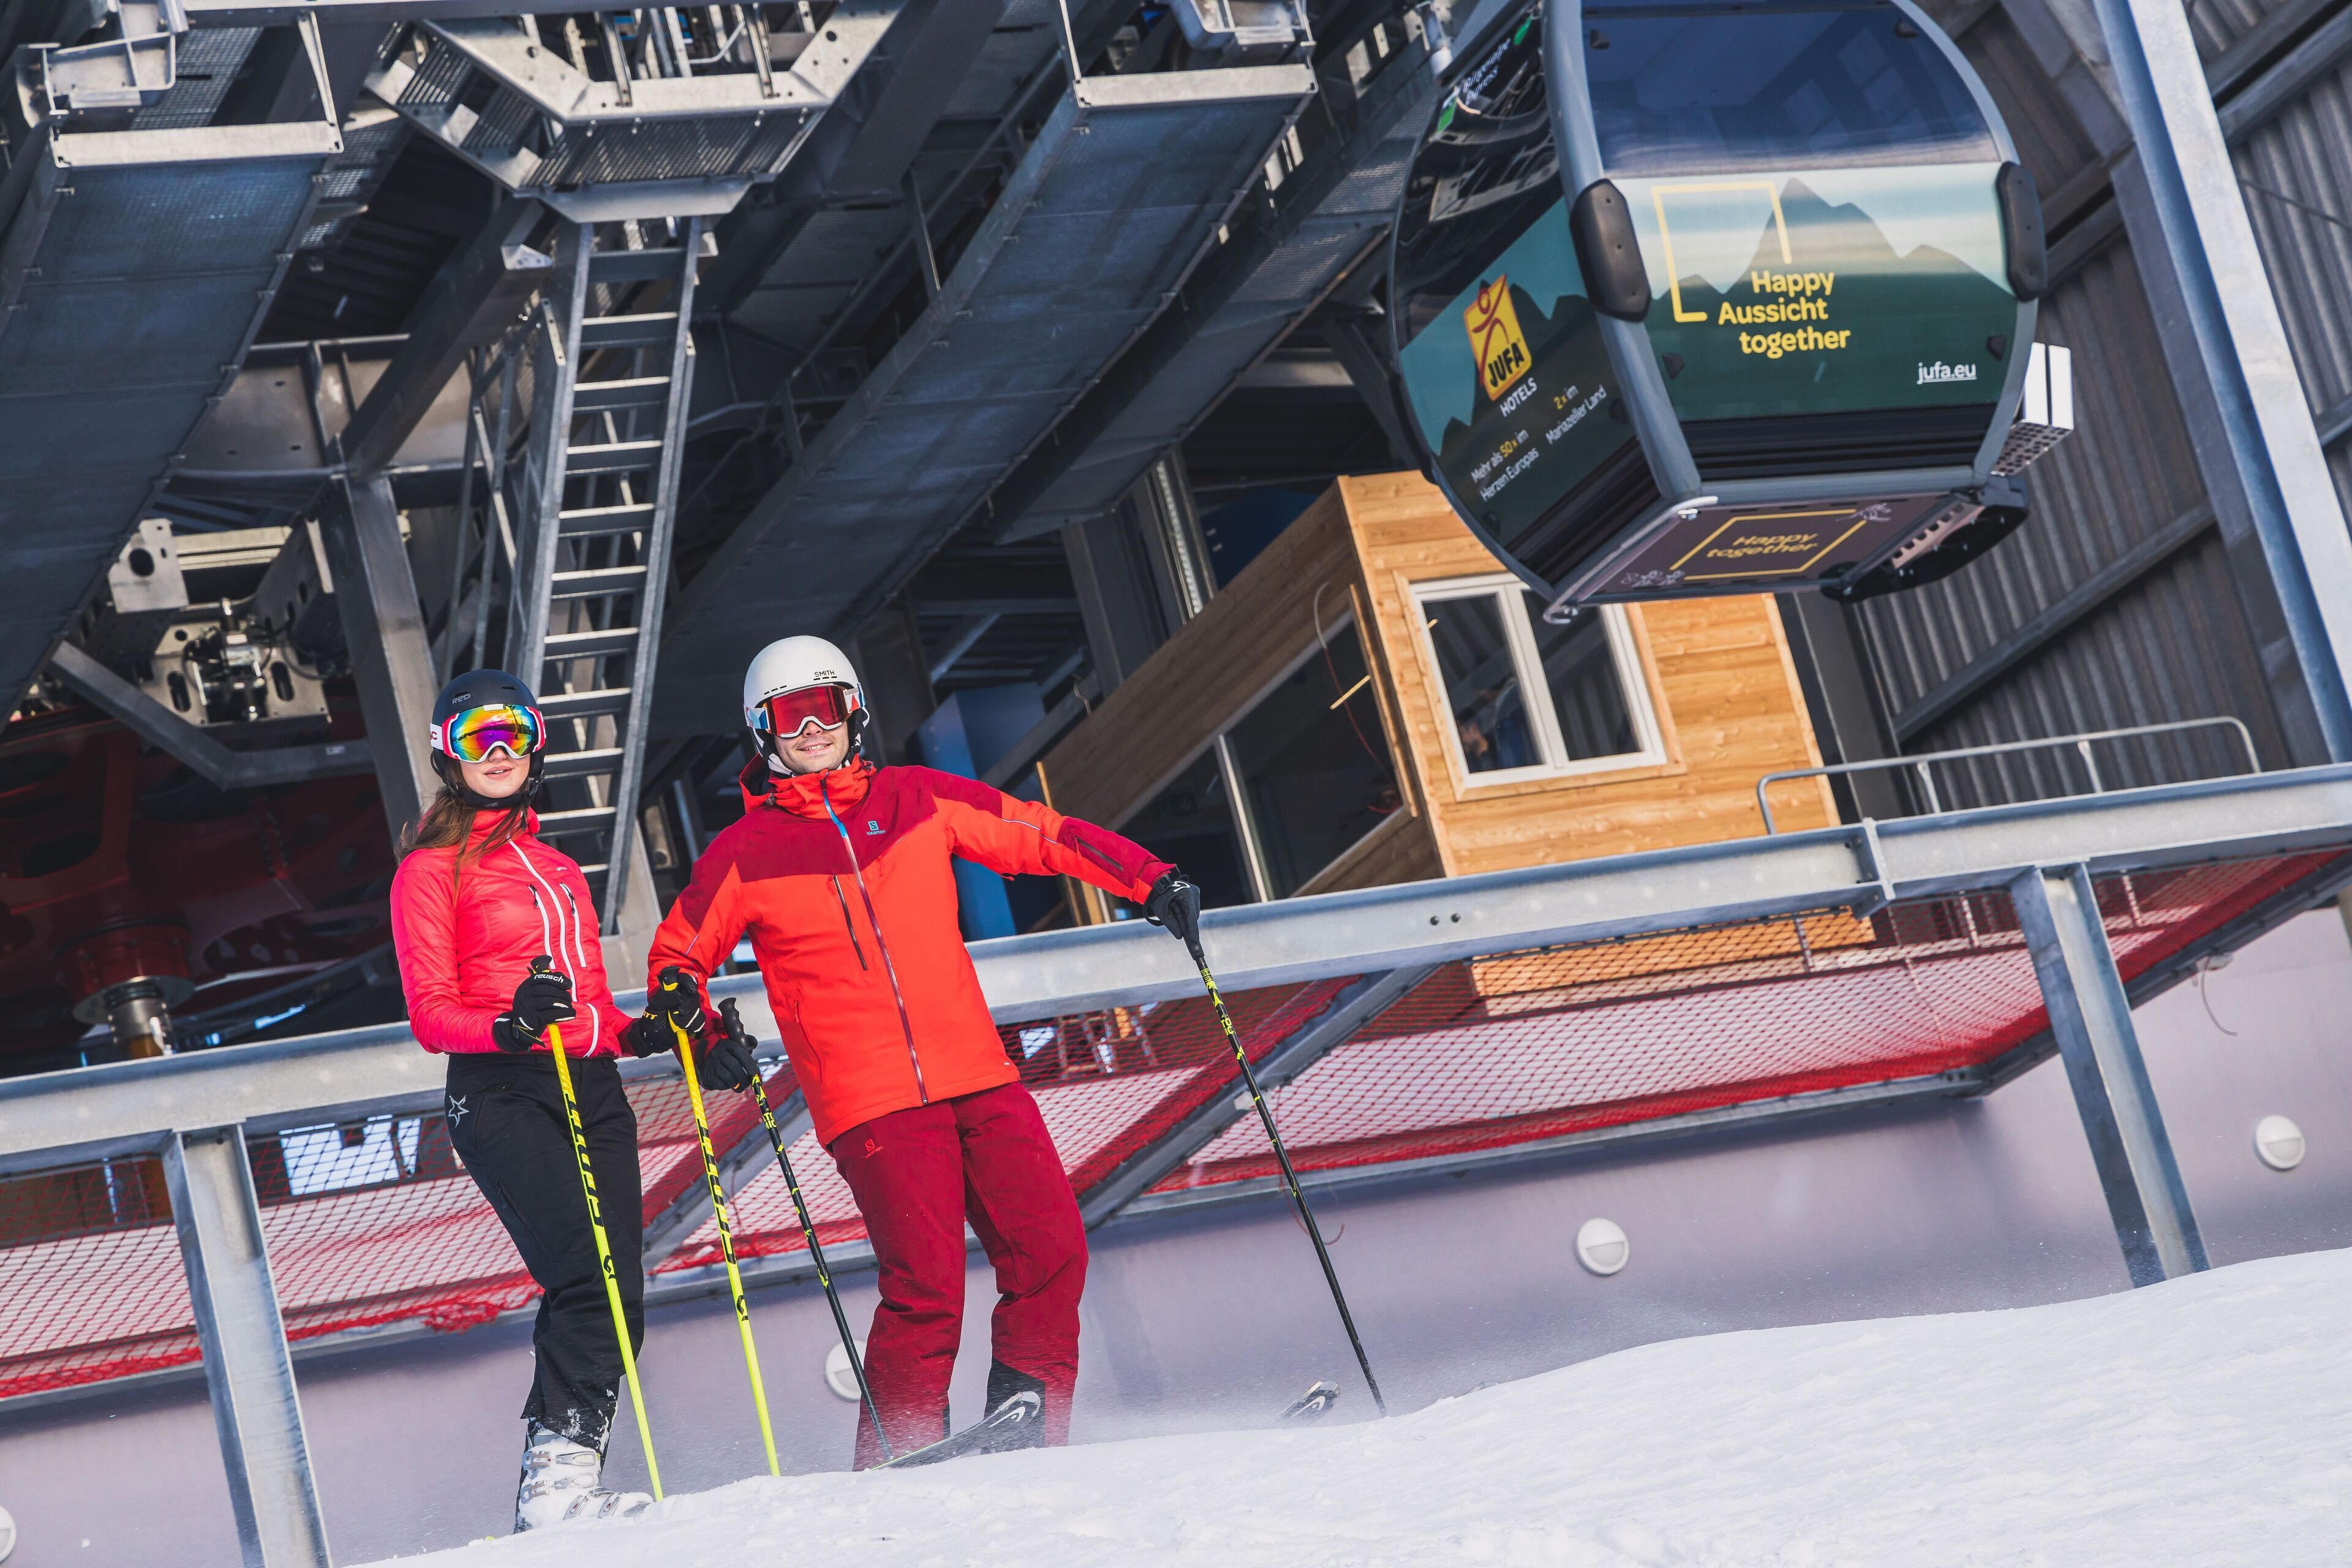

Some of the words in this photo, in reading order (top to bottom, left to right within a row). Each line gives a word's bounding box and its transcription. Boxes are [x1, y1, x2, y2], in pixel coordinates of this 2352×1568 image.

[1751, 270, 1835, 297] Happy
[1718, 296, 1829, 325] Aussicht
[1739, 325, 1851, 359] together
[1488, 342, 1525, 387] JUFA
[1917, 361, 1977, 385] jufa.eu
[1499, 377, 1538, 417] HOTELS
[1545, 404, 1588, 445] Mariazeller
[1584, 383, 1607, 410] Land
[1471, 461, 1492, 484] Mehr
[1490, 451, 1504, 467] als
[1480, 473, 1510, 502] Herzen
[1506, 448, 1539, 479] Europas
[1706, 542, 1819, 558] together
[1732, 533, 1819, 548] Happy
[533, 974, 564, 983] reusch
